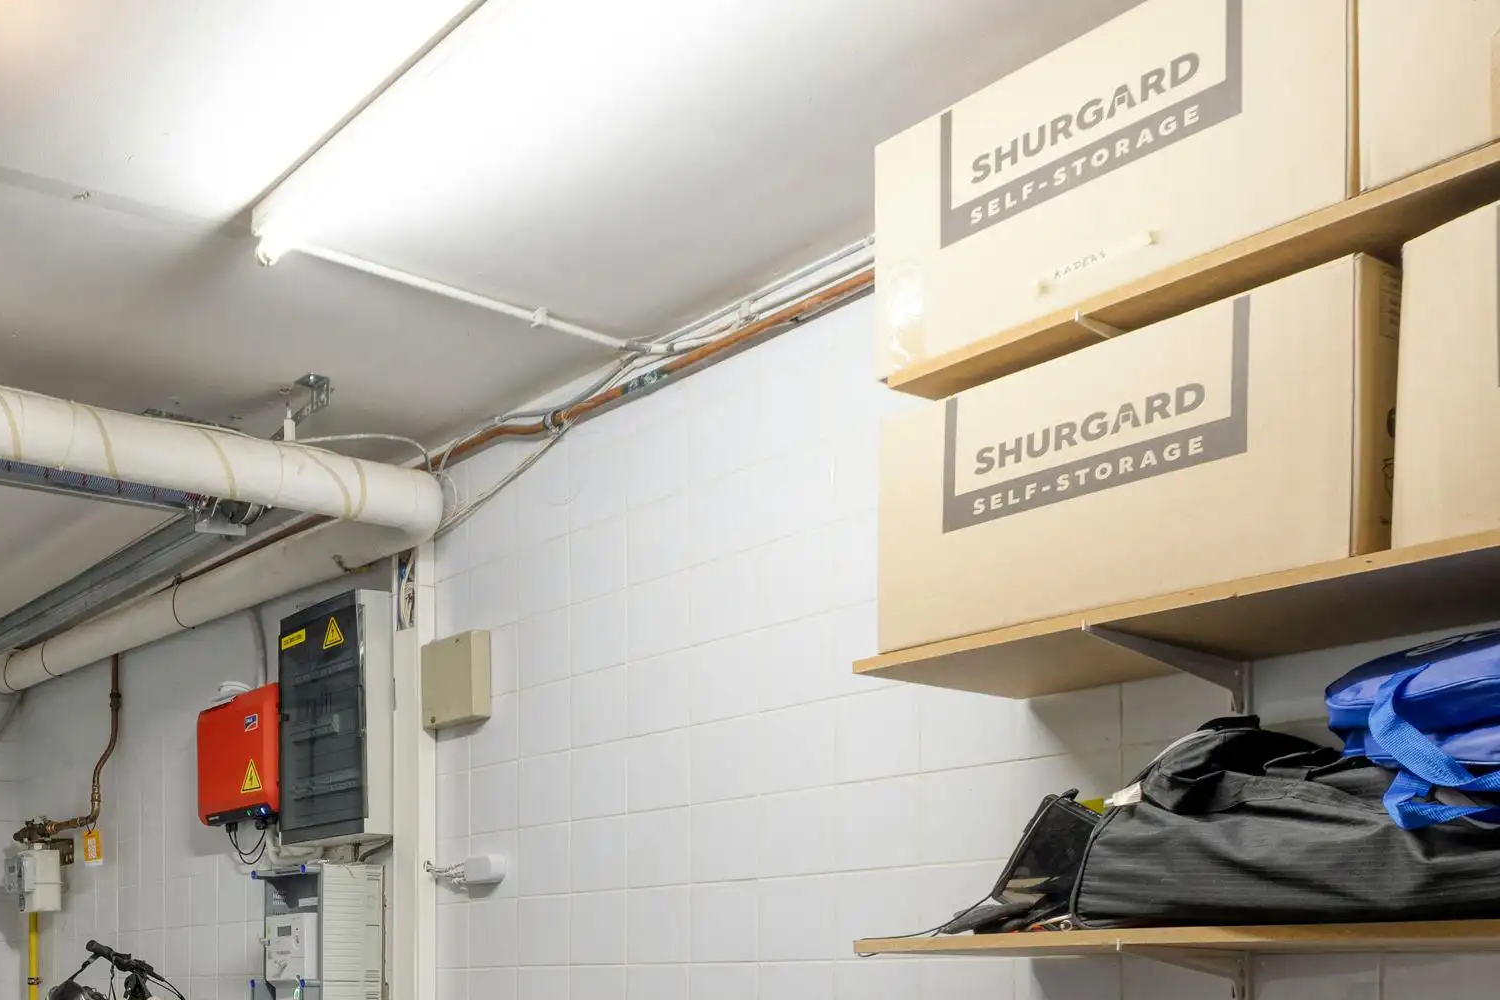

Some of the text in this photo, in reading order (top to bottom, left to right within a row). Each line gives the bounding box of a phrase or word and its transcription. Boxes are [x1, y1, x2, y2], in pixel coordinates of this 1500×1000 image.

[970, 104, 1200, 224] SELF-STORAGE
[971, 52, 1200, 184] SHURGARD
[973, 436, 1205, 515] SELF-STORAGE
[974, 383, 1206, 475] SHURGARD
